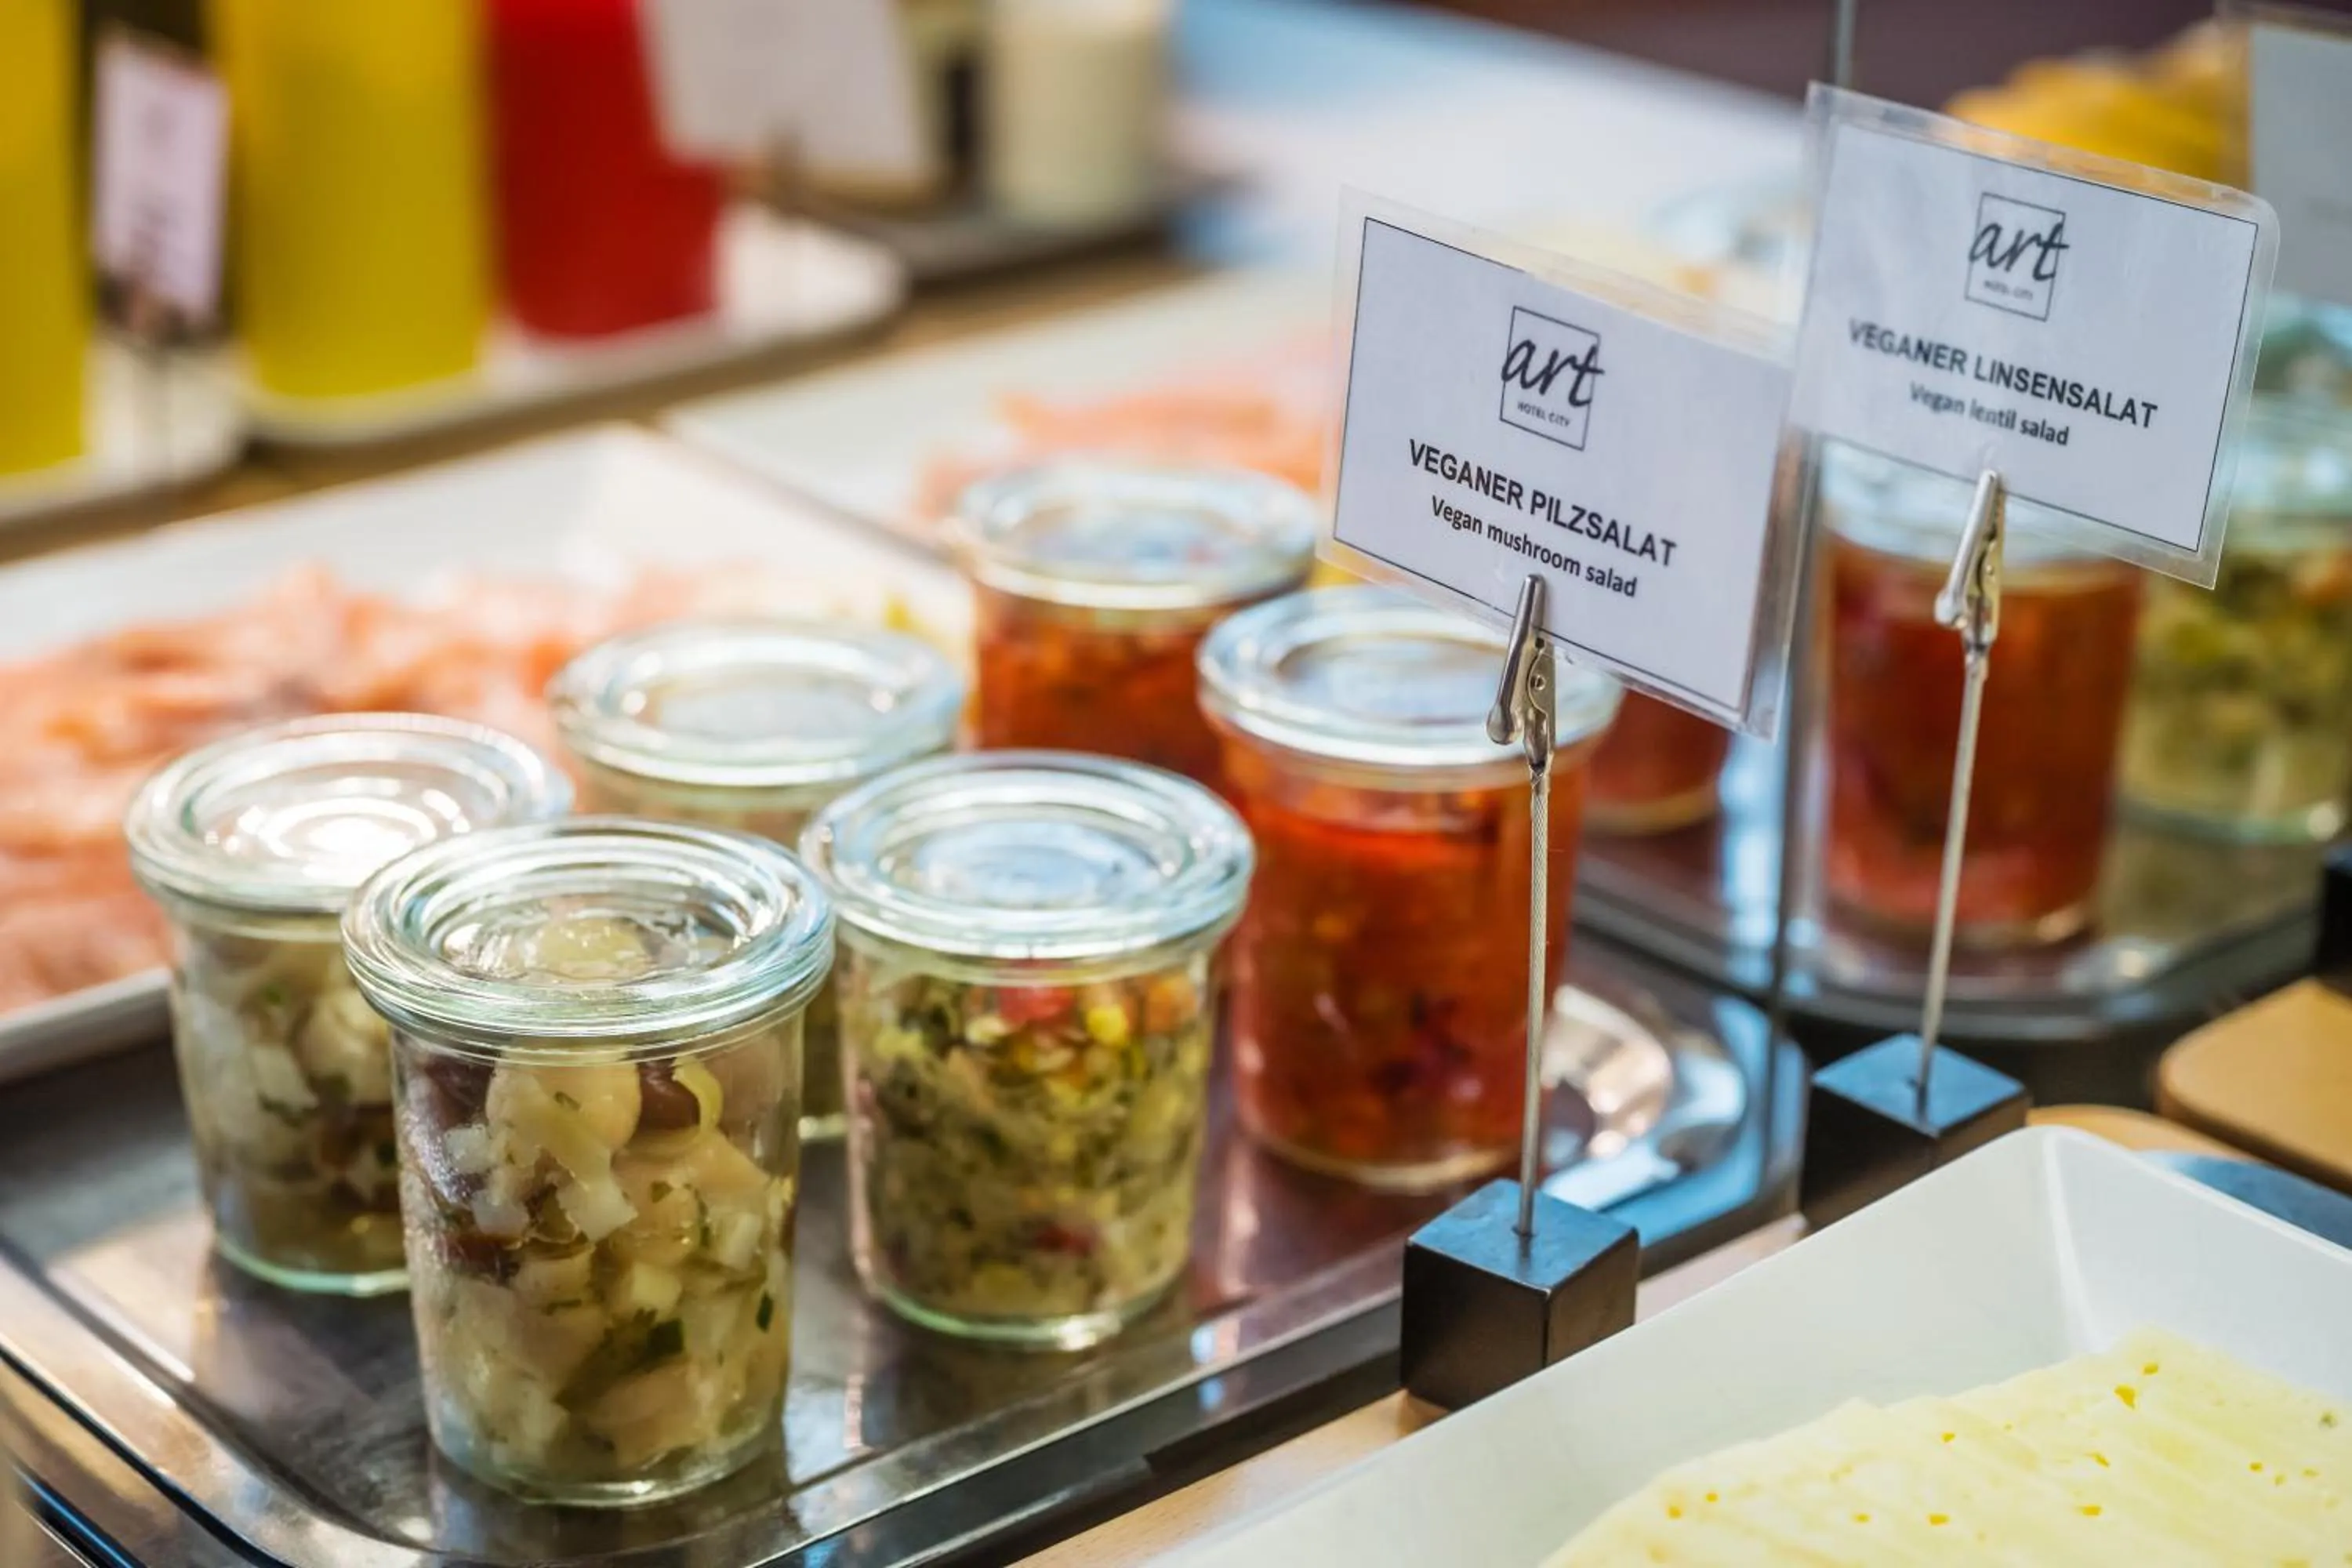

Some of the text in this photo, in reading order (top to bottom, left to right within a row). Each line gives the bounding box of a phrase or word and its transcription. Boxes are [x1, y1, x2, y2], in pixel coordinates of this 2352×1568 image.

[1968, 222, 2070, 281] art
[1501, 339, 1605, 407] art
[1848, 318, 2158, 430] VEGANER LINSENSALAT
[1517, 401, 1572, 427] HOTEL CITY
[1909, 382, 2069, 447] Vegan lentil salad
[1409, 438, 1678, 568] VEGANER PILZSALAT
[1432, 495, 1638, 598] Vegan mushroom salad
